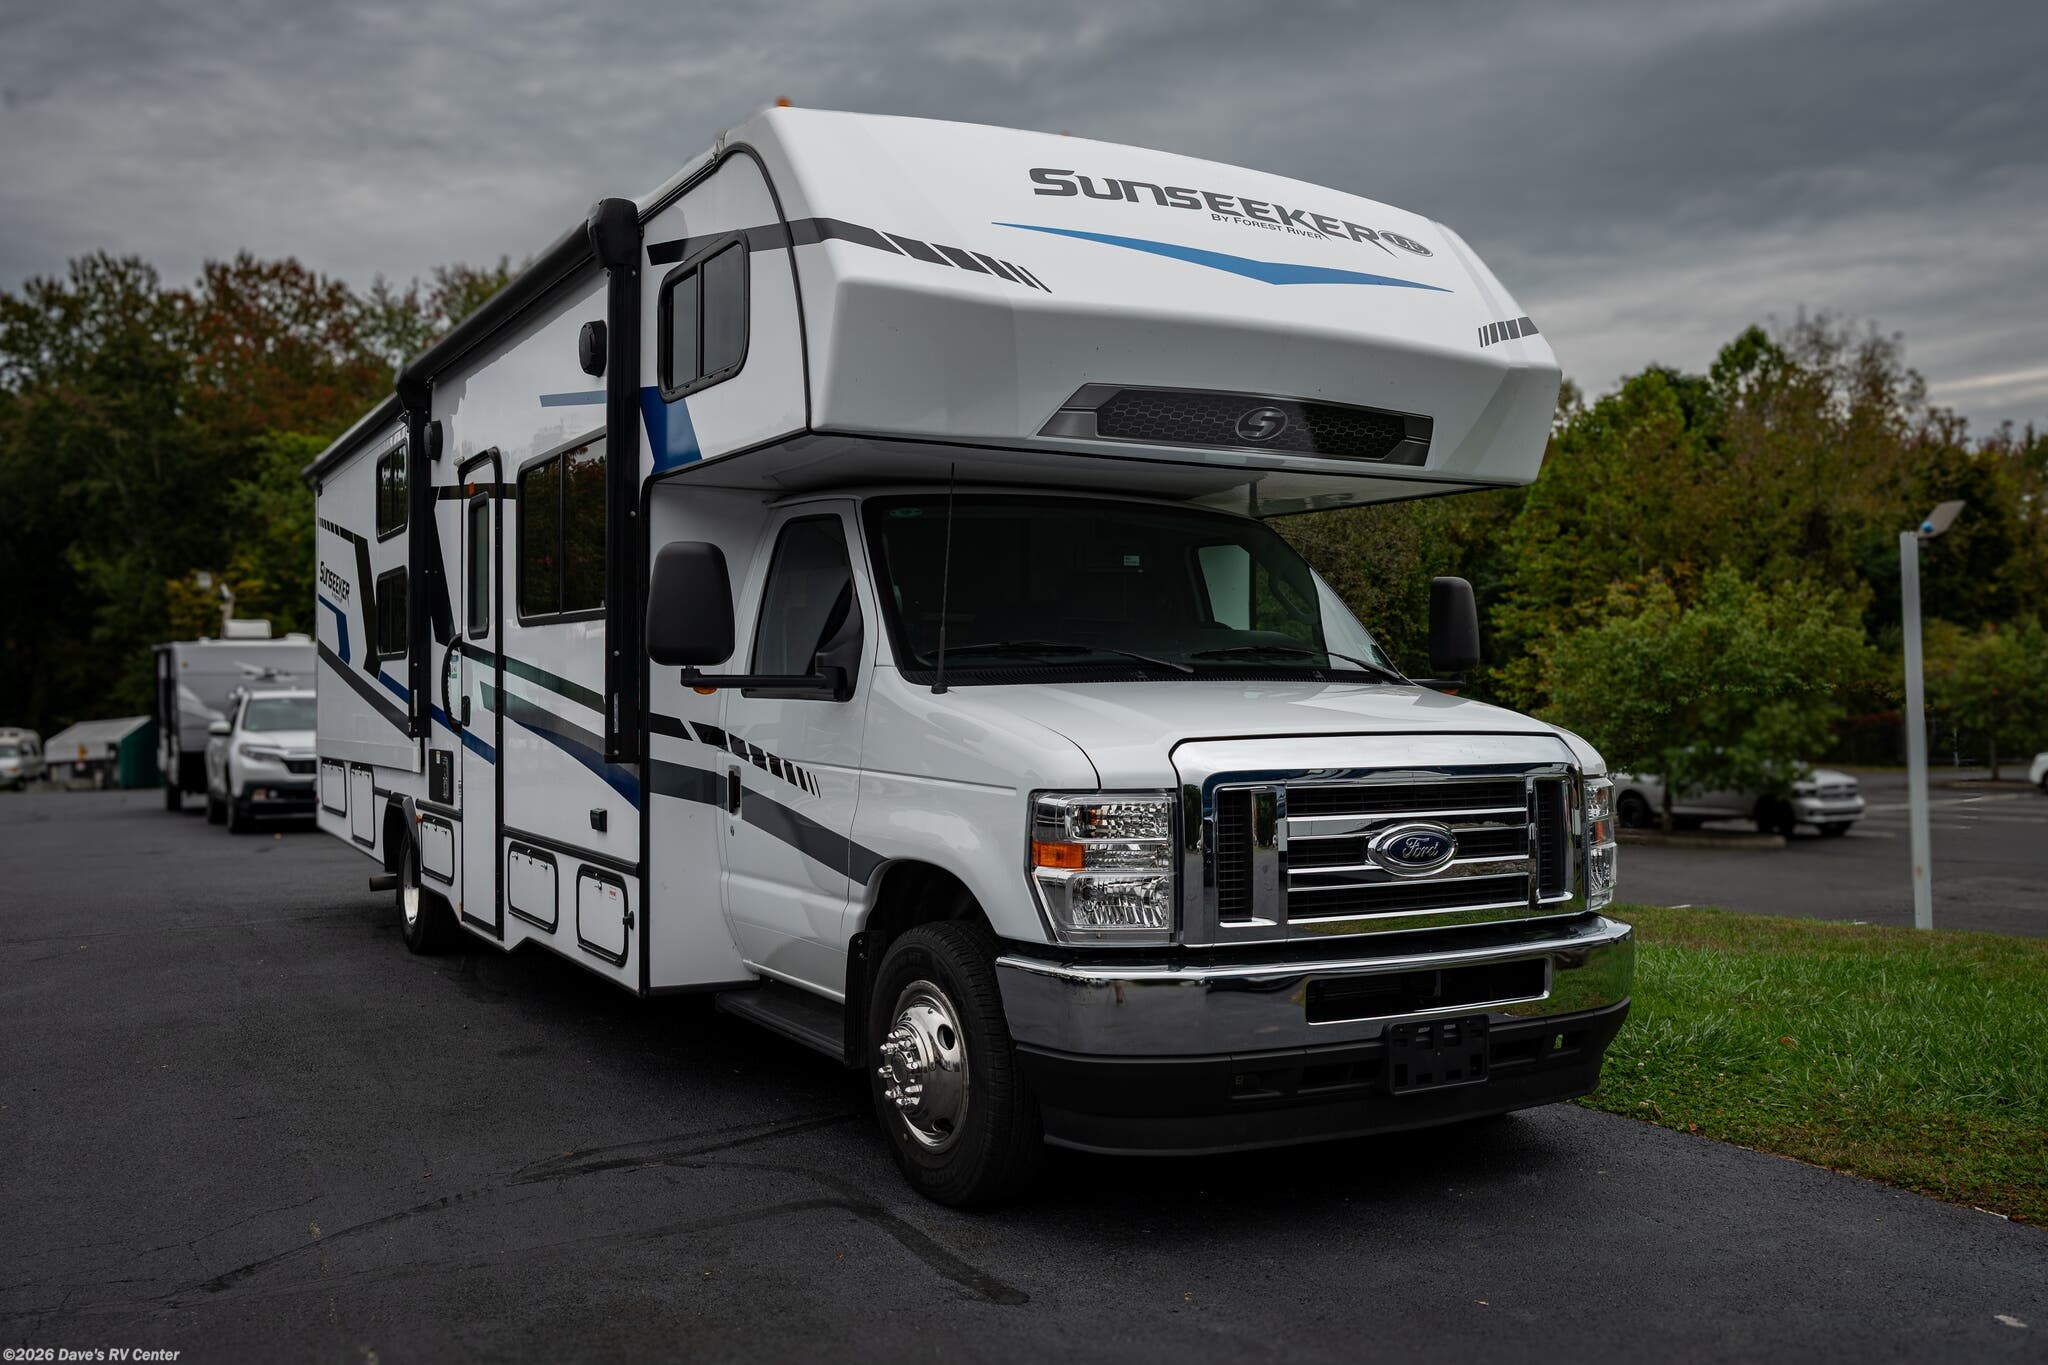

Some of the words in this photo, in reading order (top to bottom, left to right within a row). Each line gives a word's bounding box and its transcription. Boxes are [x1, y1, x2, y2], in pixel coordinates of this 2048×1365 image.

[1029, 168, 1398, 257] SUNSEEKER
[1233, 217, 1283, 232] FOREST
[1286, 226, 1323, 240] RIVER
[1402, 837, 1439, 858] Ford
